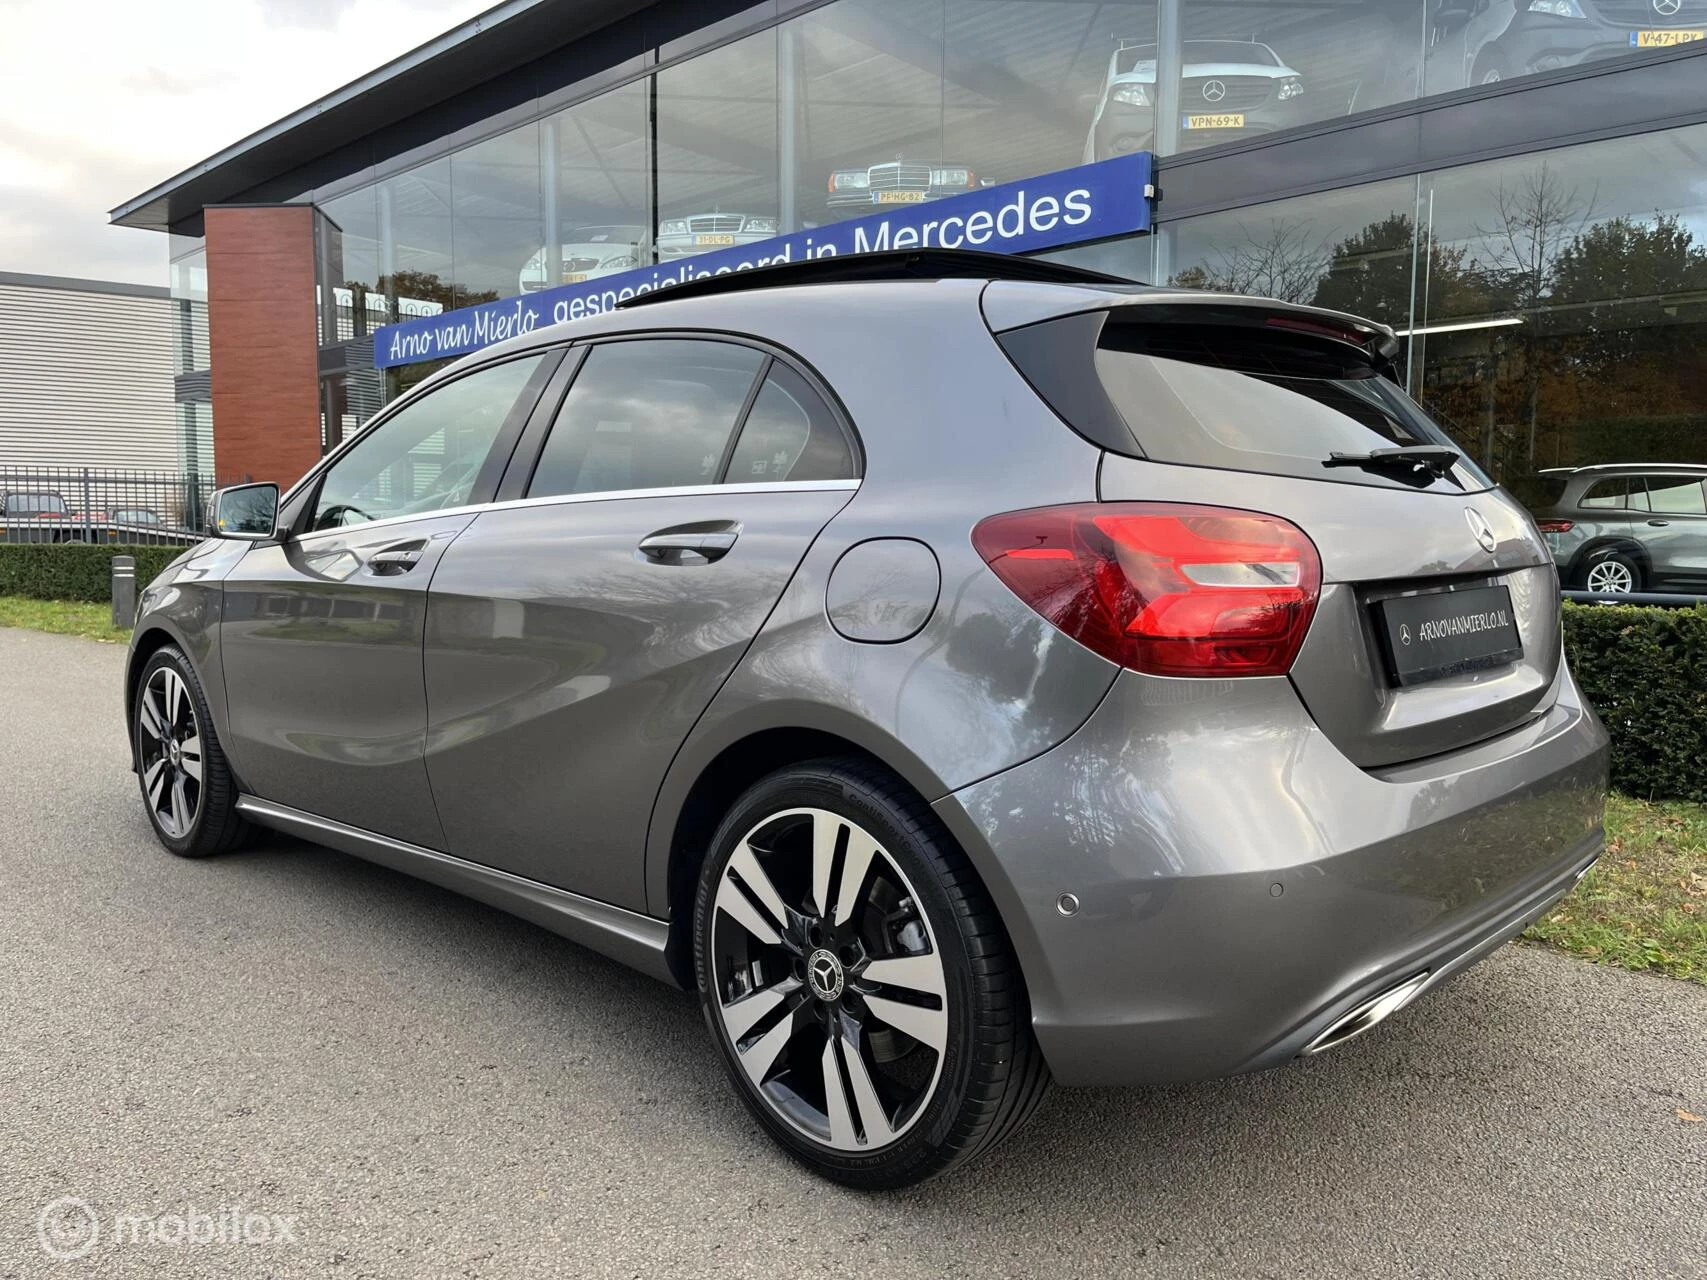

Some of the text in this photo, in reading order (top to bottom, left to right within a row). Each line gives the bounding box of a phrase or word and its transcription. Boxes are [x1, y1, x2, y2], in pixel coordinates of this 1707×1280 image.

[1191, 116, 1240, 127] VPN-69-K
[390, 330, 433, 360] Arno
[435, 322, 474, 351] van
[473, 300, 540, 345] Mierlo
[854, 188, 1092, 251] Mercedes
[1419, 610, 1509, 642] ARNOVANMIERLO.NL
